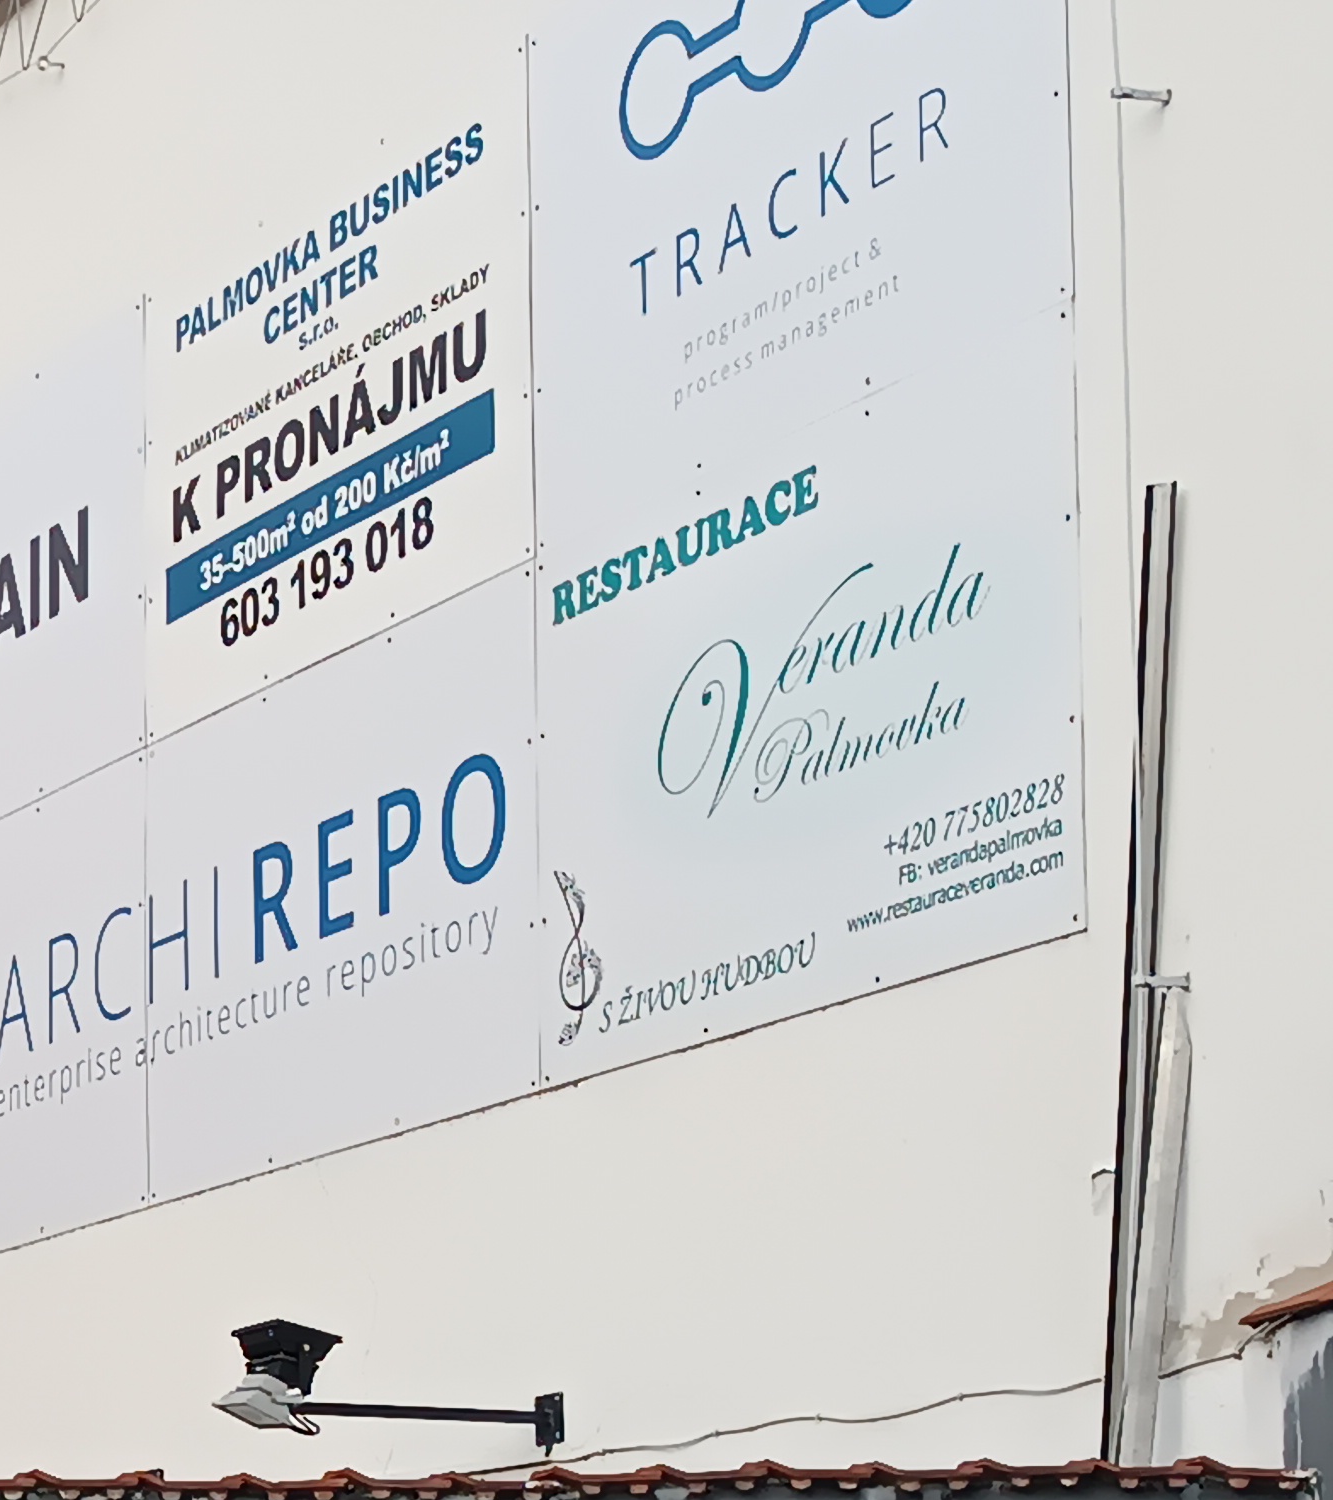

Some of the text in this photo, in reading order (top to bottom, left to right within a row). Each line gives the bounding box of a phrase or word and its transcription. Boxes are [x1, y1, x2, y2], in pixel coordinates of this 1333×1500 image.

[175, 122, 483, 353] PALMOVKA BUSINESS
[629, 87, 949, 316] TRACKER
[263, 244, 379, 344] CENTER
[298, 316, 339, 350] s.r.o.
[362, 304, 427, 353] OBCHOD,
[431, 264, 490, 312] SKLADY
[674, 275, 900, 411] process management
[683, 237, 882, 364] program/project &
[172, 308, 487, 545] K PRONÁJMU
[301, 494, 328, 535] od
[334, 471, 377, 519] 200
[552, 465, 819, 627] RESTAURACE
[220, 496, 434, 647] 603 193 018
[657, 542, 991, 818] Veranda
[753, 680, 969, 804] Palmovka
[884, 773, 1065, 856] +420 775802828
[899, 817, 1063, 886] FB: verandapalmovka
[847, 851, 1064, 933] www.restauraceveranda.com
[135, 974, 310, 1066] architecture
[326, 906, 498, 998] repository
[598, 931, 816, 1033] S ŽIVOU HUDBOU
